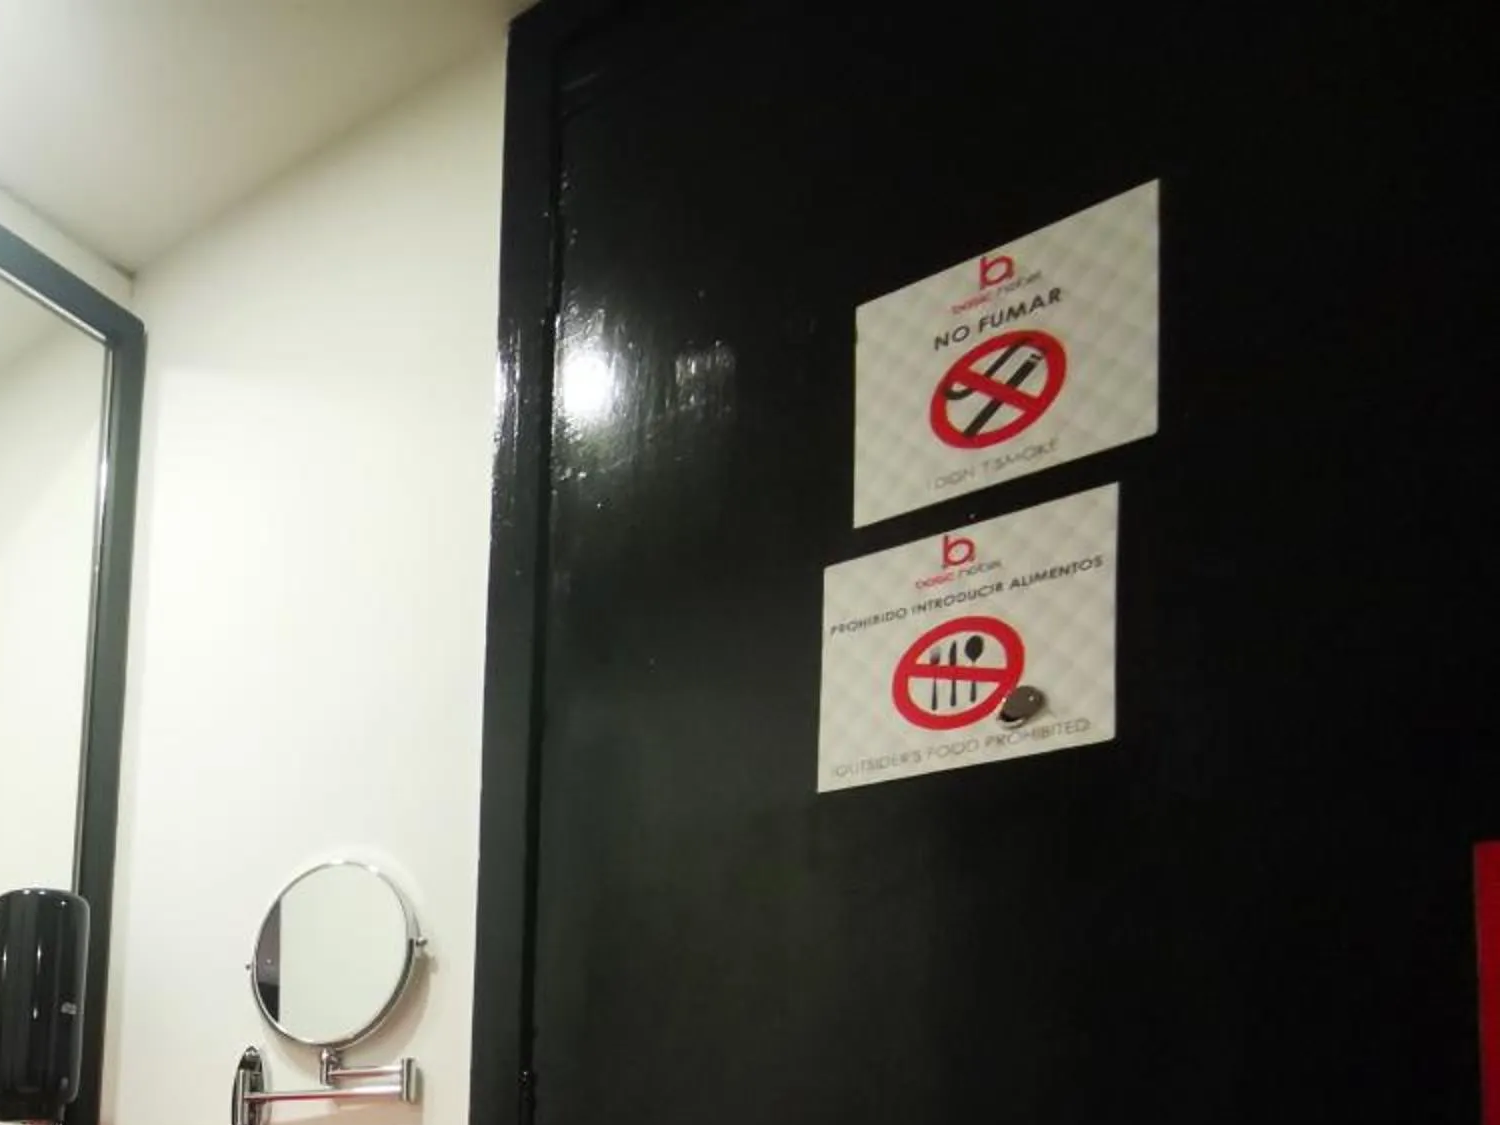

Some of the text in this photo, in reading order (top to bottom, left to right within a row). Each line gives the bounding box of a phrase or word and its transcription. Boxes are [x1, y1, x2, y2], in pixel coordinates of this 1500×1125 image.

[979, 255, 1015, 290] b
[933, 287, 1062, 350] NO FUMAR
[994, 436, 1059, 472] SMOKE
[942, 534, 976, 569] b
[830, 554, 1104, 635] PROHIBIDO INTRODUCIR ALIMENTOS
[926, 738, 980, 760] FOOD
